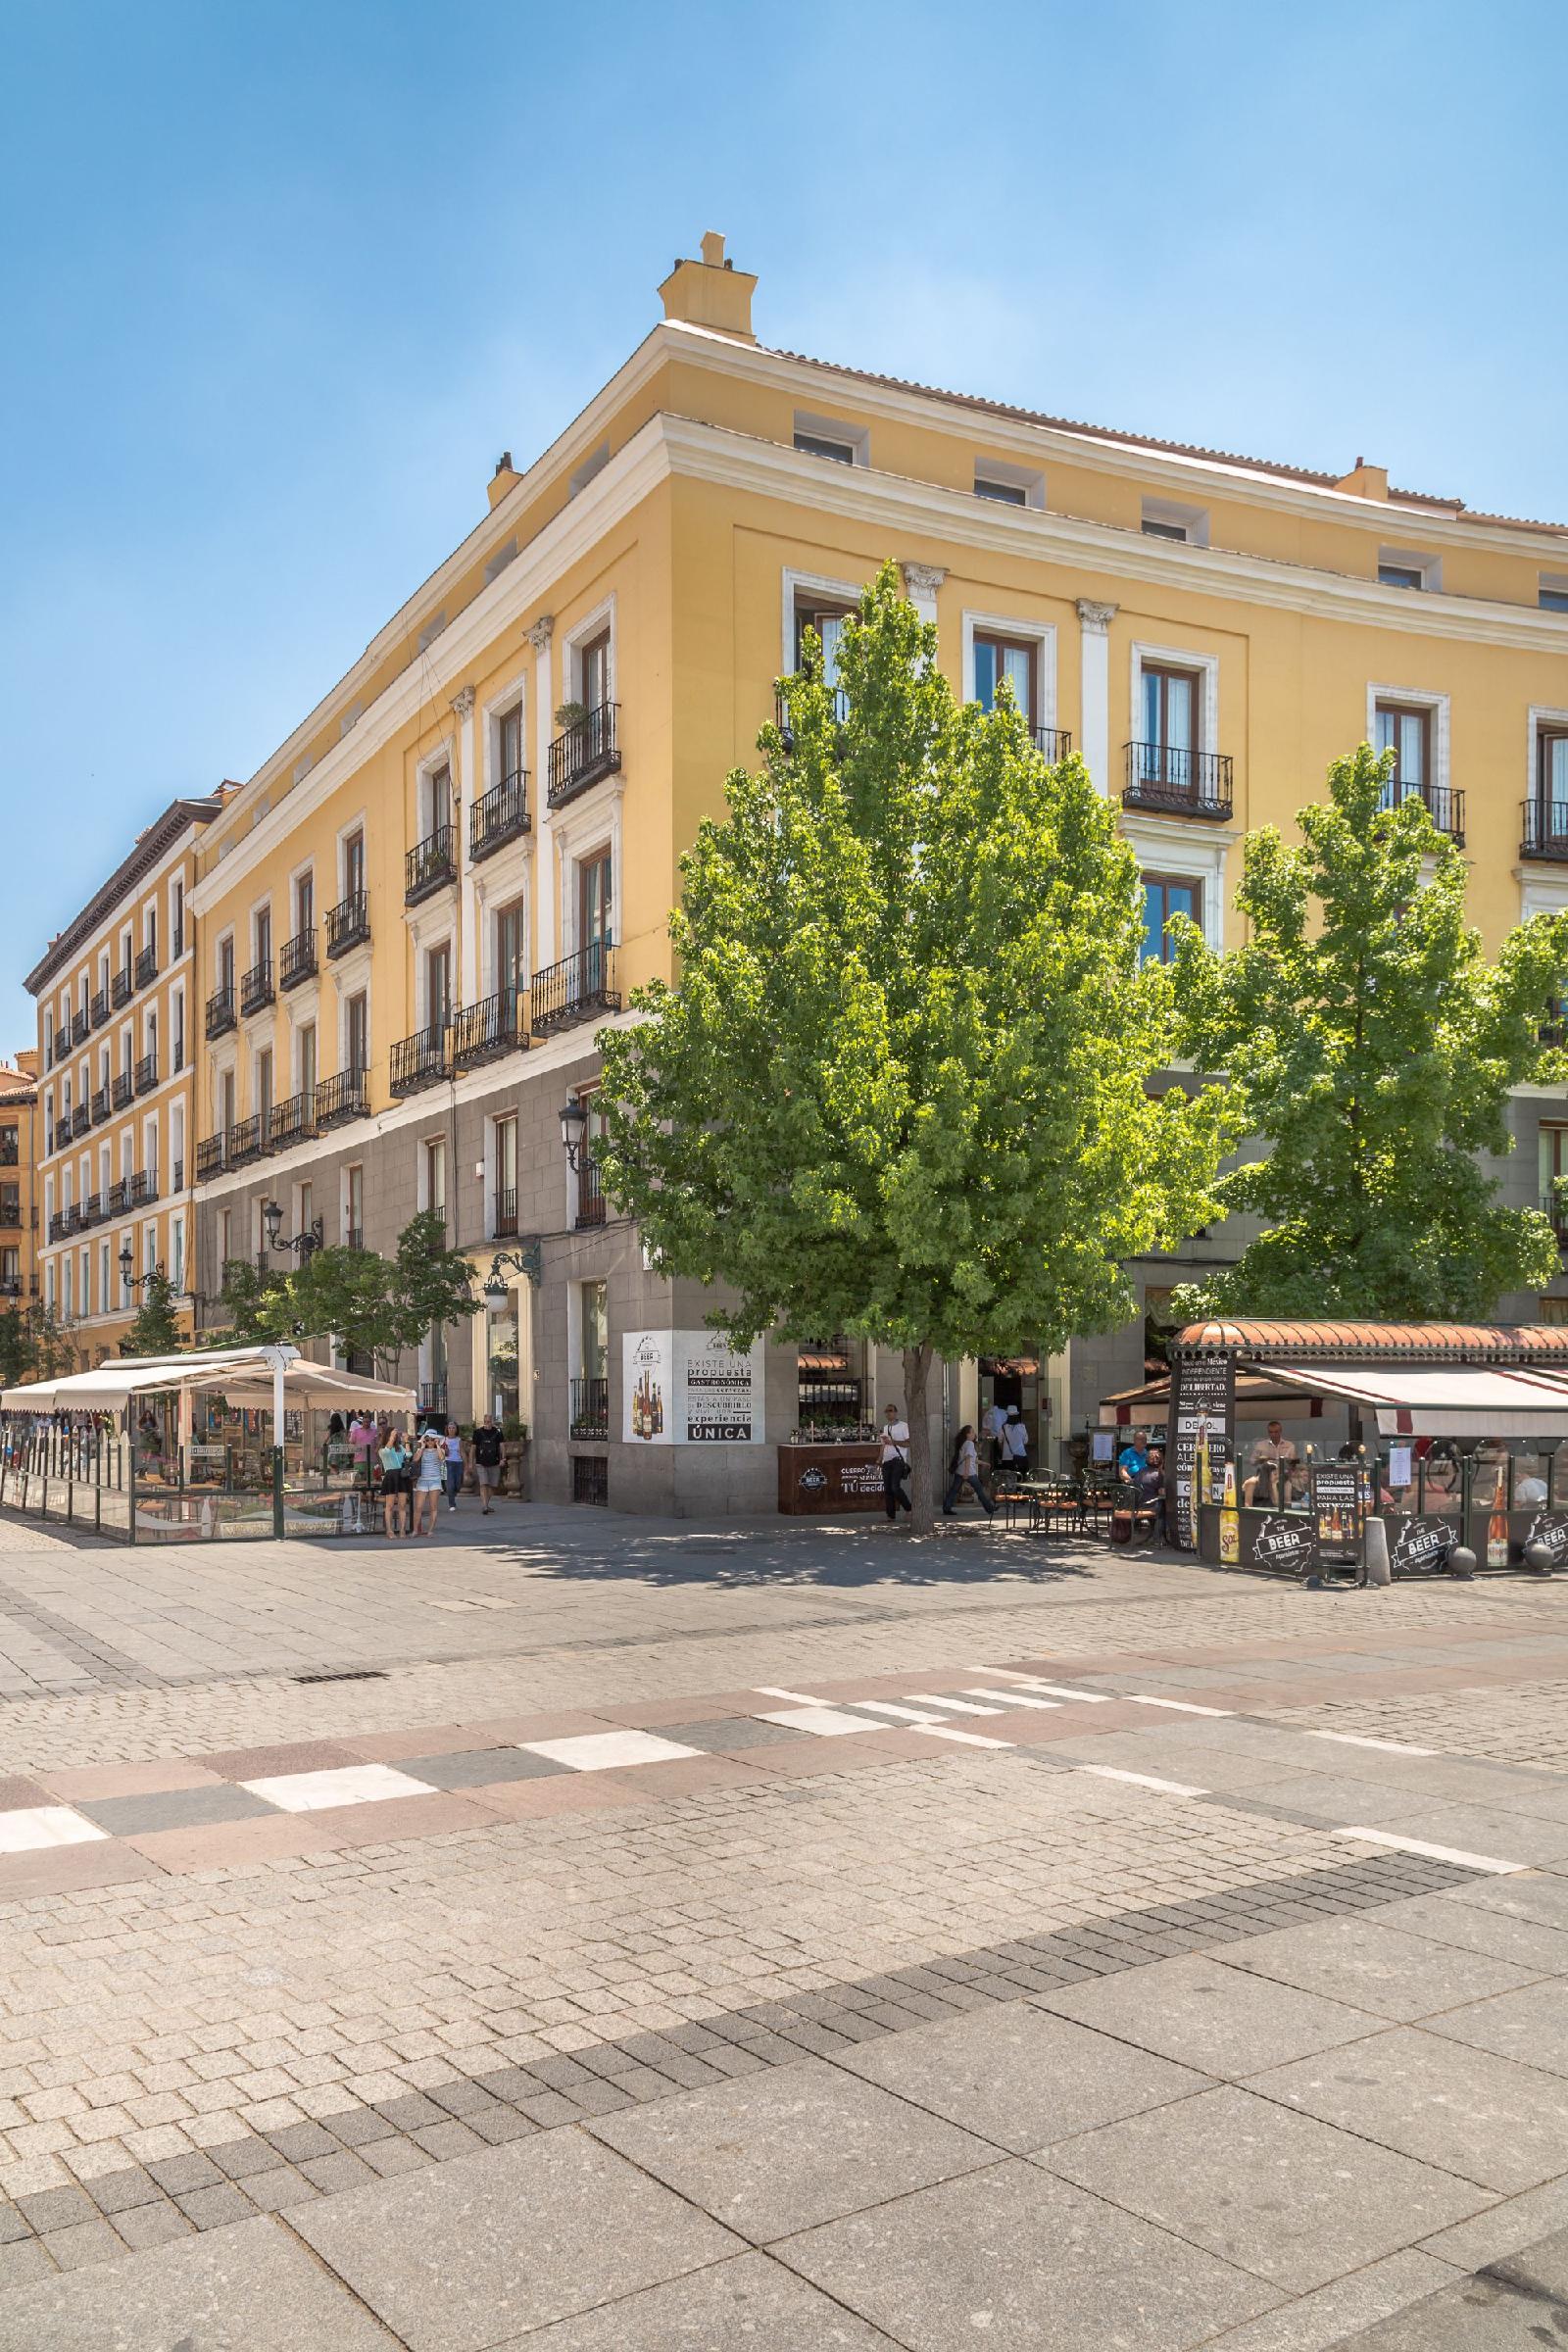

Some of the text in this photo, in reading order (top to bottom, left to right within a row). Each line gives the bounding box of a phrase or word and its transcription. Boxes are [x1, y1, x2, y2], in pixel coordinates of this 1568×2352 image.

[688, 1359, 752, 1368] EXISTE UNA
[688, 1368, 752, 1378] propuesta
[688, 1414, 752, 1423] experiencia
[692, 1424, 747, 1440] ÚNICA
[841, 1479, 885, 1493] TÚ decid
[1268, 1533, 1300, 1551] BEER
[1537, 1528, 1566, 1545] BEER
[1408, 1534, 1440, 1555] BEER
